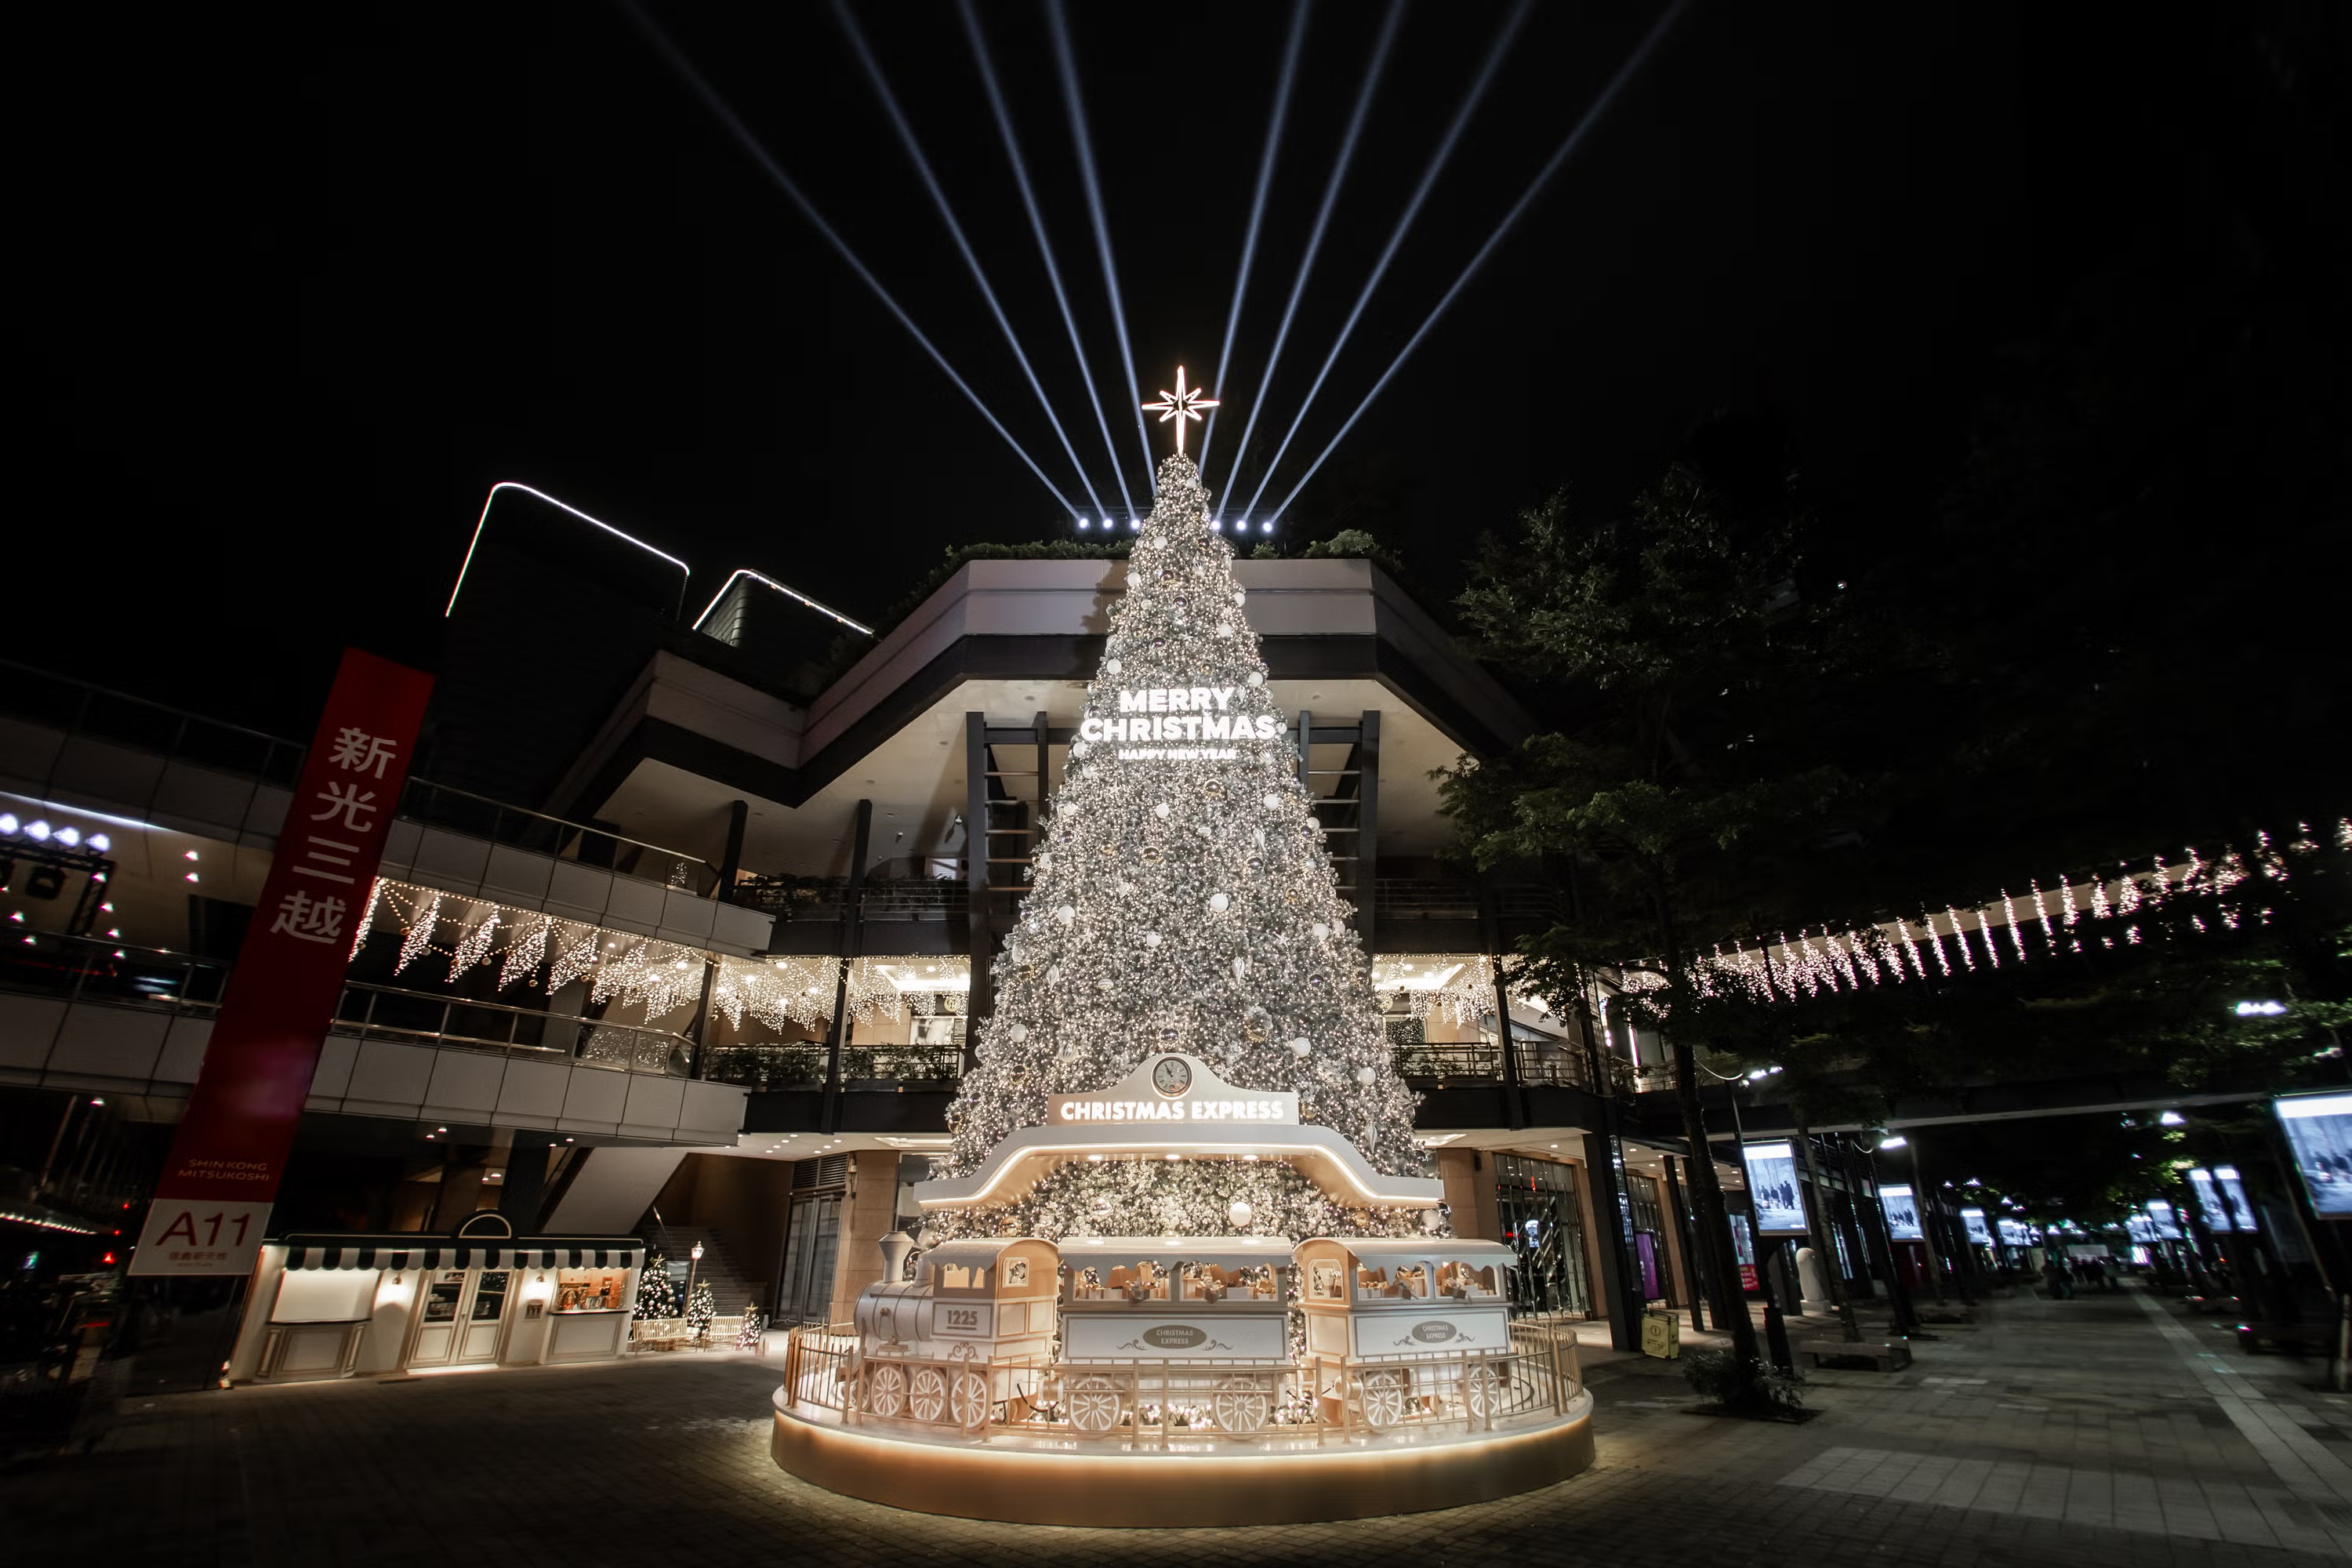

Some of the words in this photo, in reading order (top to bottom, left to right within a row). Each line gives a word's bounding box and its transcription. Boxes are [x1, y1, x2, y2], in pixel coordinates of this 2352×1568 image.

[1120, 687, 1235, 713] MERRY
[1080, 715, 1276, 742] CHRISTMAS
[1119, 749, 1166, 760] HAPPY
[1167, 749, 1200, 760] NEW
[1200, 749, 1236, 760] YEAR
[270, 727, 397, 945] 新光三越
[1061, 1101, 1185, 1120] CHRISTMAS
[1192, 1101, 1283, 1120] EXPRESS
[188, 1159, 224, 1168] SHIN
[227, 1161, 267, 1171] KONG
[176, 1169, 270, 1181] MITSUKOSHI
[155, 1211, 250, 1246] A11
[947, 1310, 978, 1326] 1225
